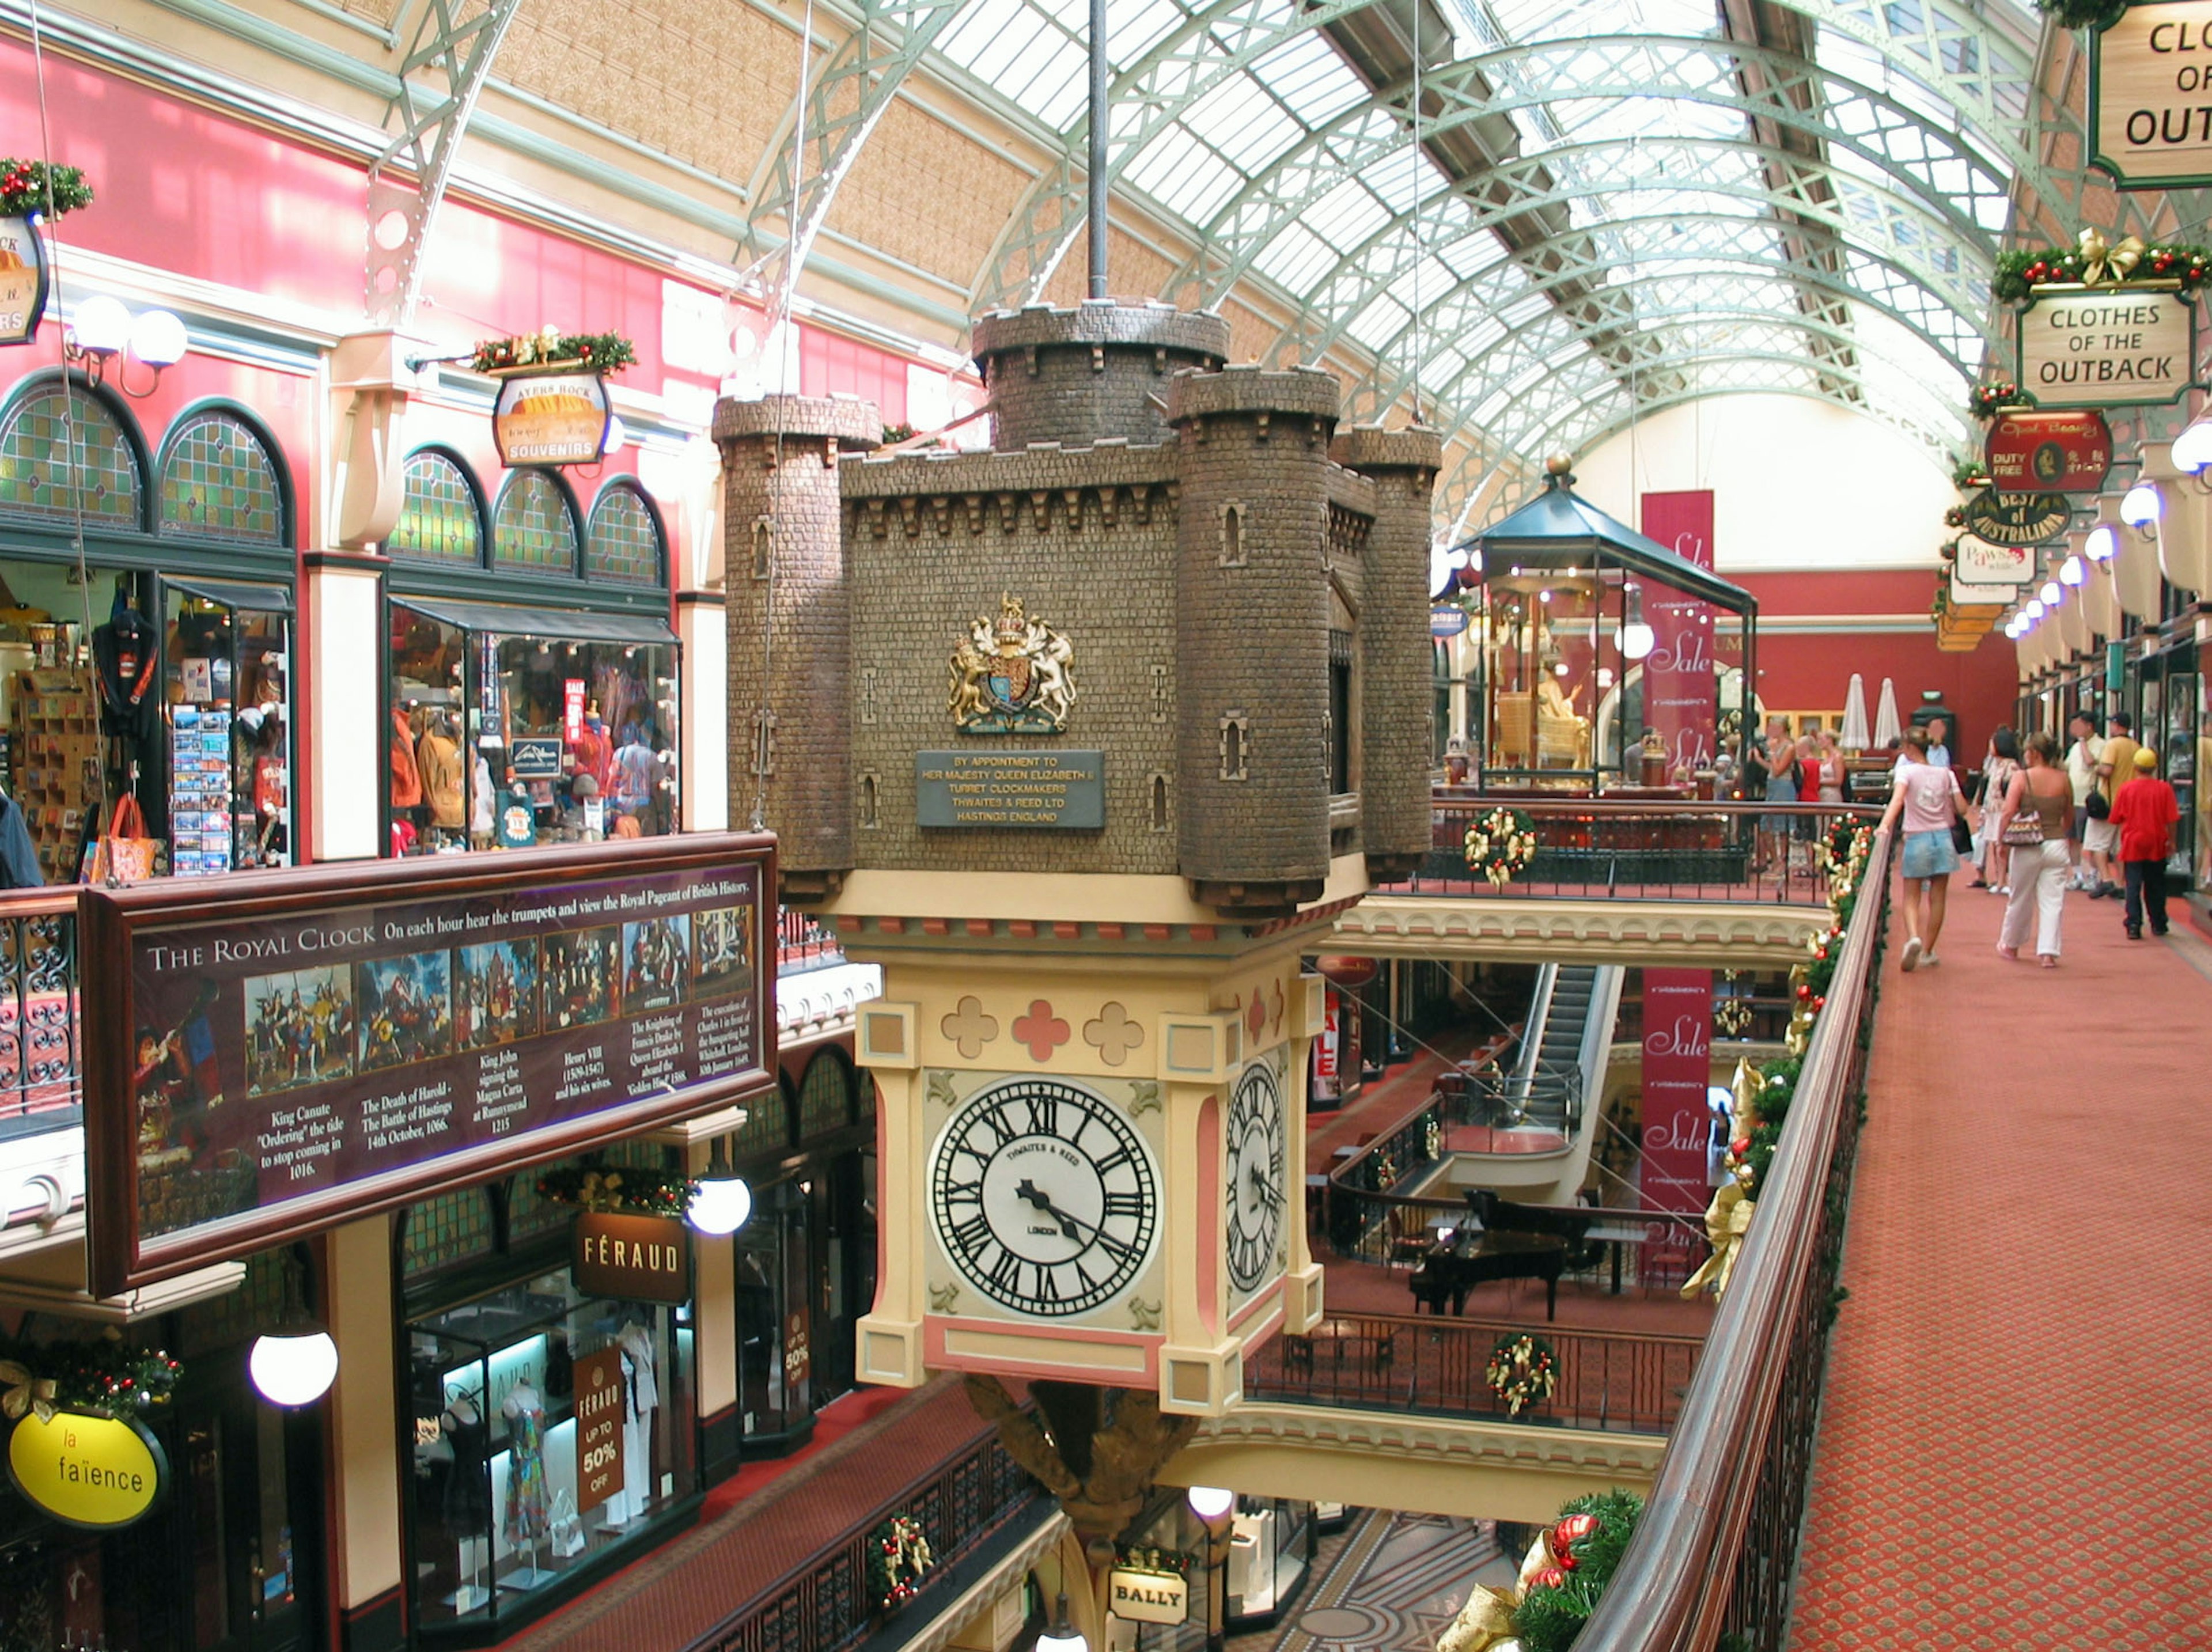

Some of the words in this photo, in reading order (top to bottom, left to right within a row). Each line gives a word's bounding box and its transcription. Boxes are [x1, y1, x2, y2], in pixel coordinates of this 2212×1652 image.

[2050, 305, 2160, 328] CLOTHES
[2069, 335, 2094, 351] OF
[2104, 333, 2142, 350] THE
[2039, 356, 2172, 383] OUTBACK
[518, 385, 554, 399] AYERS
[559, 385, 590, 397] ROCK
[510, 442, 592, 457] SOUVENIRS
[1993, 453, 2026, 463] DUTY
[1994, 465, 2022, 475] FREE
[1999, 494, 2038, 508] BEST
[2012, 507, 2027, 523] of
[1972, 513, 2067, 543] AUSTRALIANA
[1647, 630, 1710, 673] Sale
[954, 757, 968, 767] BY
[971, 757, 1039, 767] APPOINTMENT
[1044, 757, 1058, 767] TO
[923, 770, 942, 779] HER
[945, 770, 990, 779] MAJESTY
[994, 771, 1028, 780] QUEEN
[1031, 771, 1085, 780] ELIZABETH
[949, 784, 986, 794] TURRET
[990, 784, 1066, 794] CLOCKMAKERS
[952, 797, 1002, 808] THWAITES
[1006, 798, 1012, 807] &
[1016, 798, 1041, 808] REED
[1045, 798, 1065, 808] LTD
[957, 812, 1006, 822] HASTINGS
[1009, 812, 1057, 822] ENGLAND
[384, 922, 404, 939] On
[407, 917, 434, 937] each
[437, 916, 464, 933] hour
[466, 912, 490, 929] hear
[493, 908, 509, 925] the
[512, 904, 556, 923] trumpets
[558, 899, 576, 916] and
[579, 899, 601, 912] view
[604, 895, 618, 911] the
[620, 891, 646, 910] Royal
[647, 890, 681, 906] Pageant
[682, 885, 691, 899] of
[693, 883, 718, 898] British
[719, 881, 749, 896] History.
[702, 1006, 713, 1018] The
[714, 1001, 740, 1015] execution
[740, 996, 747, 1009] of
[632, 1021, 645, 1034] The
[645, 1016, 675, 1030] Knighting
[675, 1011, 683, 1024] of
[632, 1034, 654, 1049] Francis
[654, 1029, 673, 1044] Drake
[673, 1028, 682, 1040] by
[1646, 1015, 1707, 1056] Sale
[480, 1055, 498, 1069] King
[499, 1049, 518, 1067] John
[565, 1052, 586, 1066] Henry
[588, 1045, 602, 1059] VIII
[630, 1052, 652, 1067] Queen
[652, 1043, 679, 1059] Elizabeth
[479, 1070, 506, 1088] signing
[506, 1066, 519, 1079] the
[642, 1060, 662, 1077] aboard
[663, 1059, 673, 1071] the
[362, 1099, 380, 1115] The
[381, 1091, 407, 1111] Death
[408, 1087, 418, 1104] of
[419, 1081, 447, 1101] Harold
[476, 1090, 501, 1104] Magna
[503, 1083, 524, 1097] Carta
[555, 1084, 569, 1100] and
[569, 1083, 580, 1097] his
[581, 1081, 591, 1093] six
[271, 1111, 296, 1128] King
[297, 1104, 331, 1121] Canute
[362, 1117, 380, 1133] The
[382, 1109, 407, 1128] Battle
[408, 1105, 417, 1121] of
[419, 1101, 453, 1119] Hastings
[473, 1110, 481, 1122] at
[482, 1096, 527, 1119] Runnymead
[1027, 1097, 1058, 1135] XII
[310, 1121, 325, 1137] the
[327, 1116, 344, 1132] tide
[492, 1117, 510, 1134] 1215
[982, 1105, 1016, 1147] XI
[1073, 1110, 1092, 1145] I
[1644, 1109, 1705, 1150] Sale
[368, 1132, 387, 1150] 14th
[388, 1125, 425, 1144] October,
[262, 1157, 272, 1169] to
[274, 1151, 294, 1166] stop
[296, 1141, 330, 1155] coming
[332, 1136, 342, 1151] in
[956, 1136, 991, 1169] X
[1007, 1143, 1046, 1160] THWAITES
[1050, 1145, 1055, 1153] &
[1059, 1148, 1080, 1166] REED
[1096, 1146, 1130, 1175] II
[290, 1161, 316, 1180] 1016.
[948, 1179, 981, 1204] IX
[1106, 1191, 1142, 1217] III
[955, 1214, 993, 1263] VIII
[1027, 1226, 1057, 1235] LONDON
[585, 1234, 677, 1272] FÉRAUD
[990, 1249, 1022, 1292] VII
[1036, 1265, 1059, 1299] VI
[1075, 1260, 1097, 1294] V
[787, 1336, 796, 1348] UP
[797, 1331, 805, 1343] TO
[785, 1344, 809, 1370] 50%
[579, 1384, 618, 1419] FÉRAUD
[64, 1429, 76, 1448] la
[586, 1427, 599, 1442] UP
[600, 1420, 612, 1435] TO
[584, 1440, 616, 1473] 50%
[60, 1456, 142, 1492] faïence
[590, 1473, 608, 1492] OFF
[1116, 1585, 1181, 1606] BALLY
